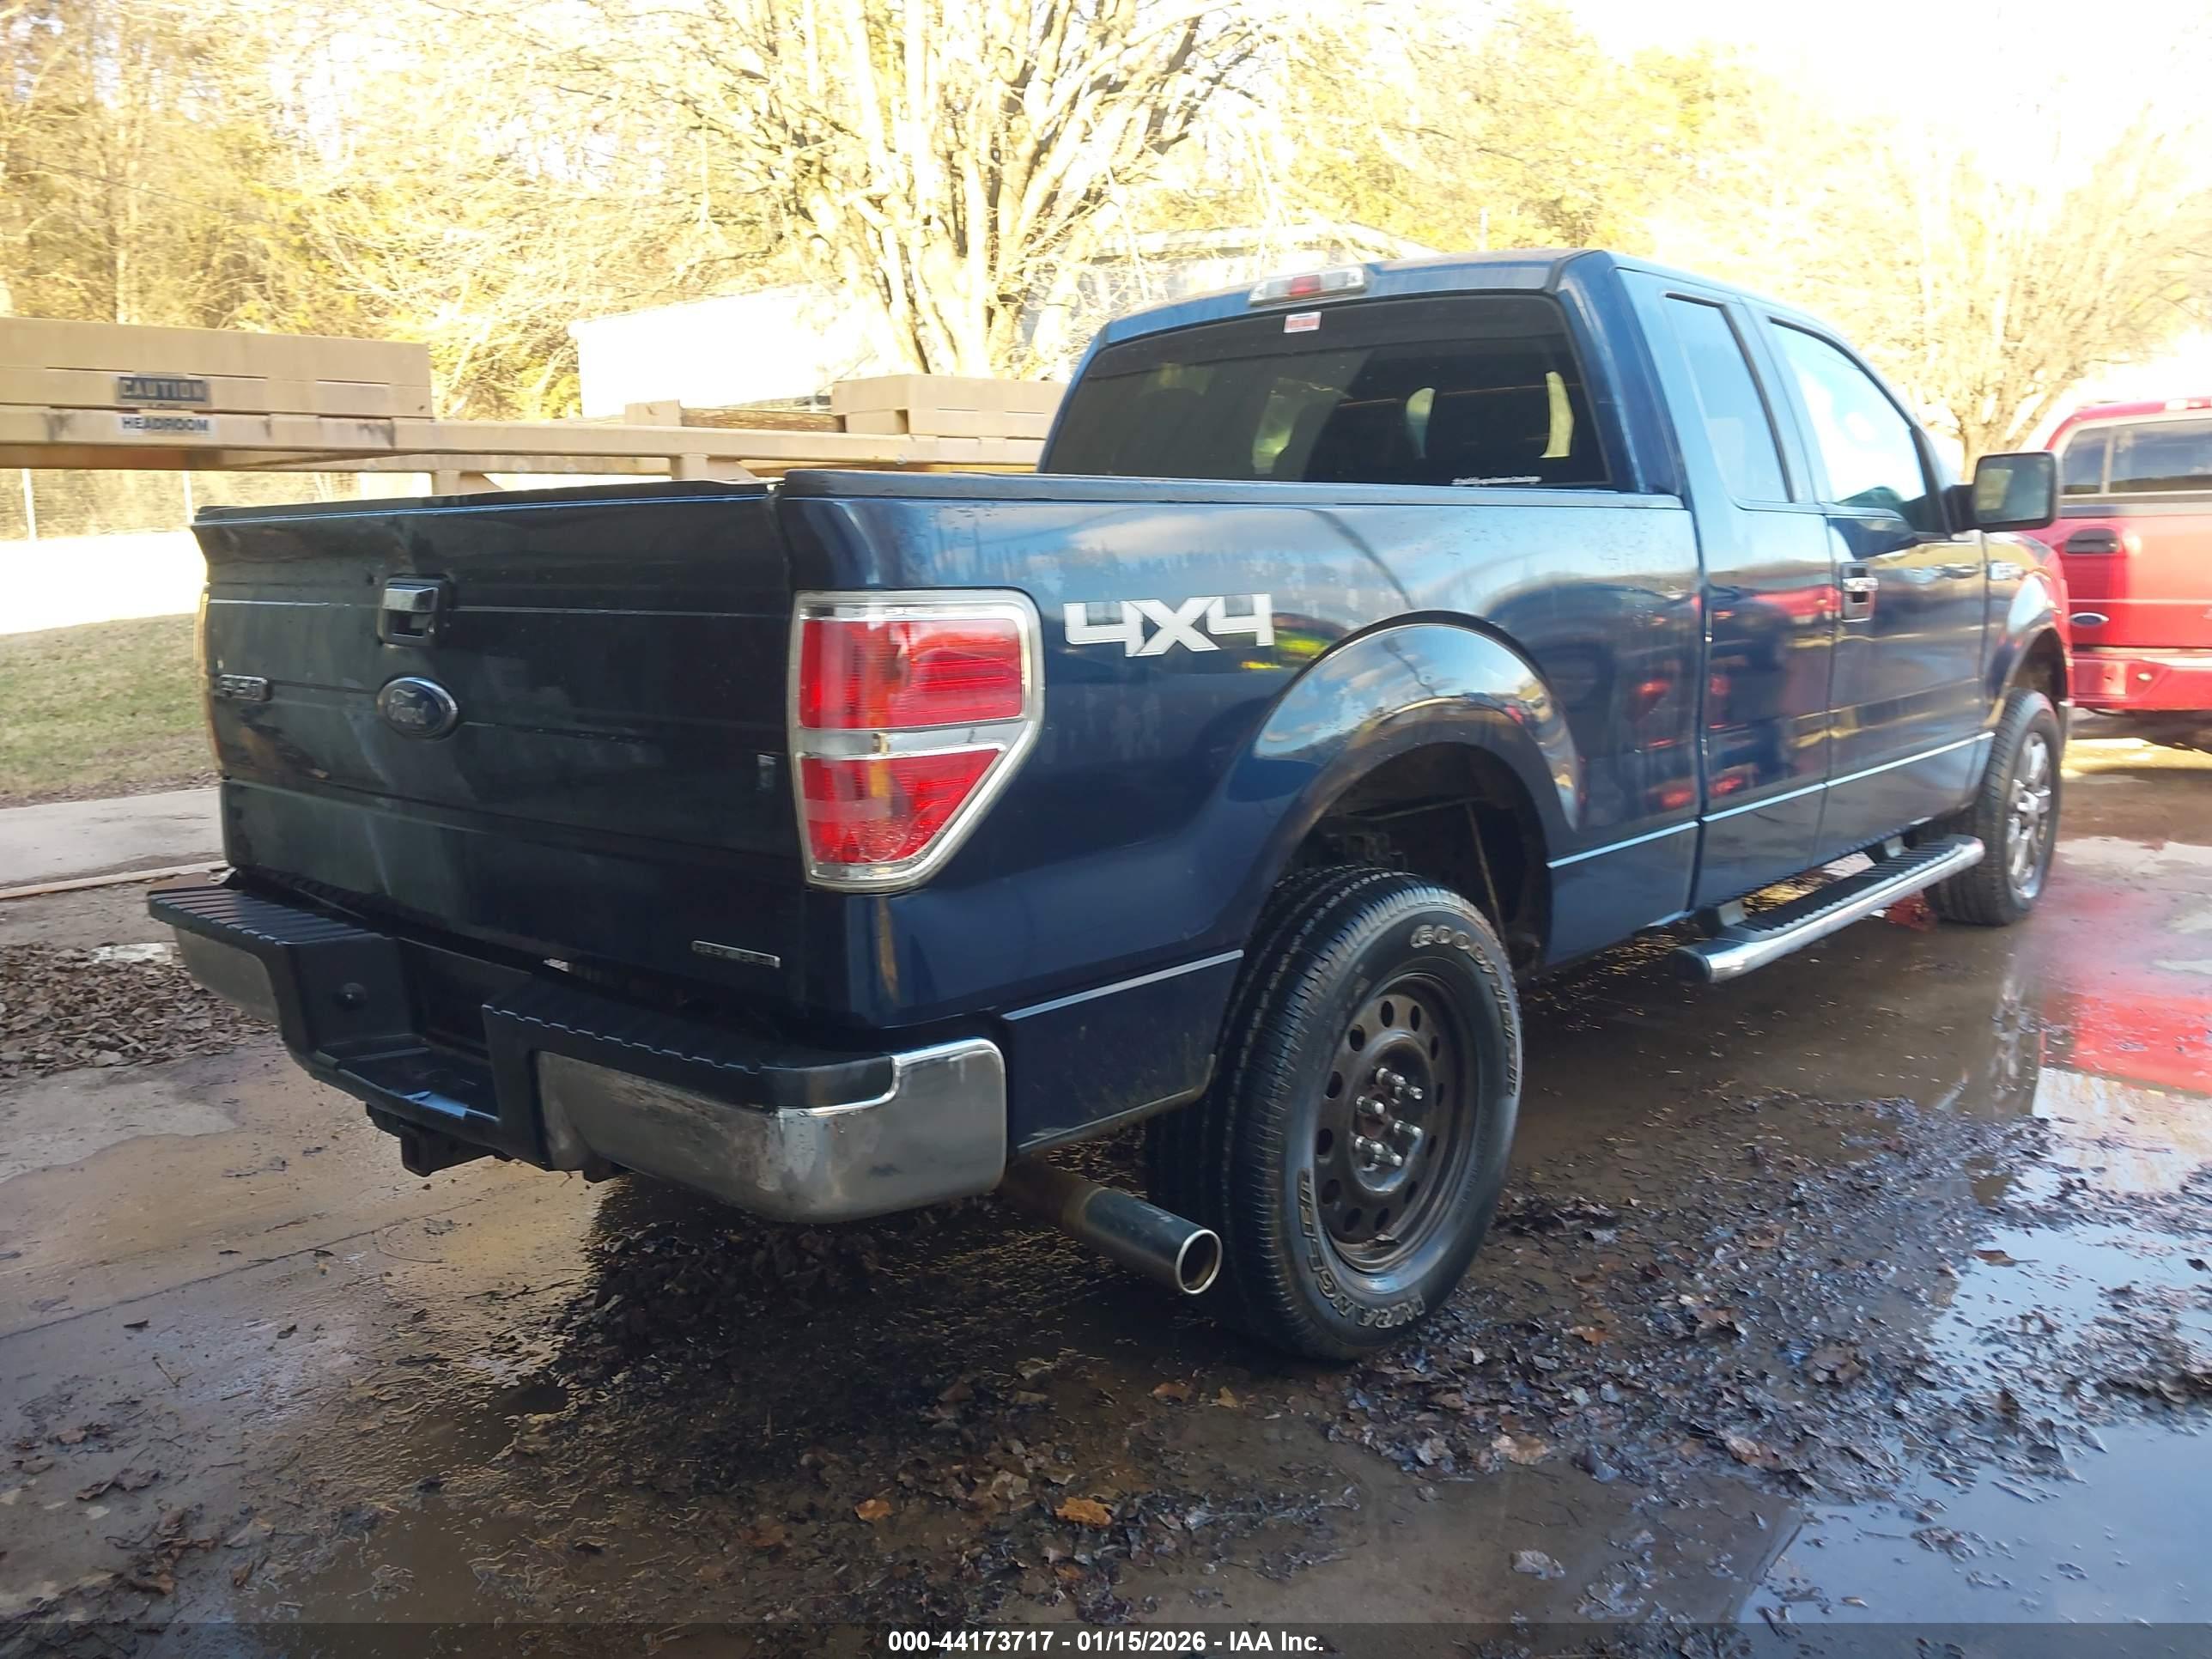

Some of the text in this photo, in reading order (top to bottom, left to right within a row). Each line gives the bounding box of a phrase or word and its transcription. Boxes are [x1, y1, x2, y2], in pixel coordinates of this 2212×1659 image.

[122, 380, 205, 398] CAUTION
[122, 417, 208, 431] HEADROOM
[1063, 593, 1275, 657] 4X4
